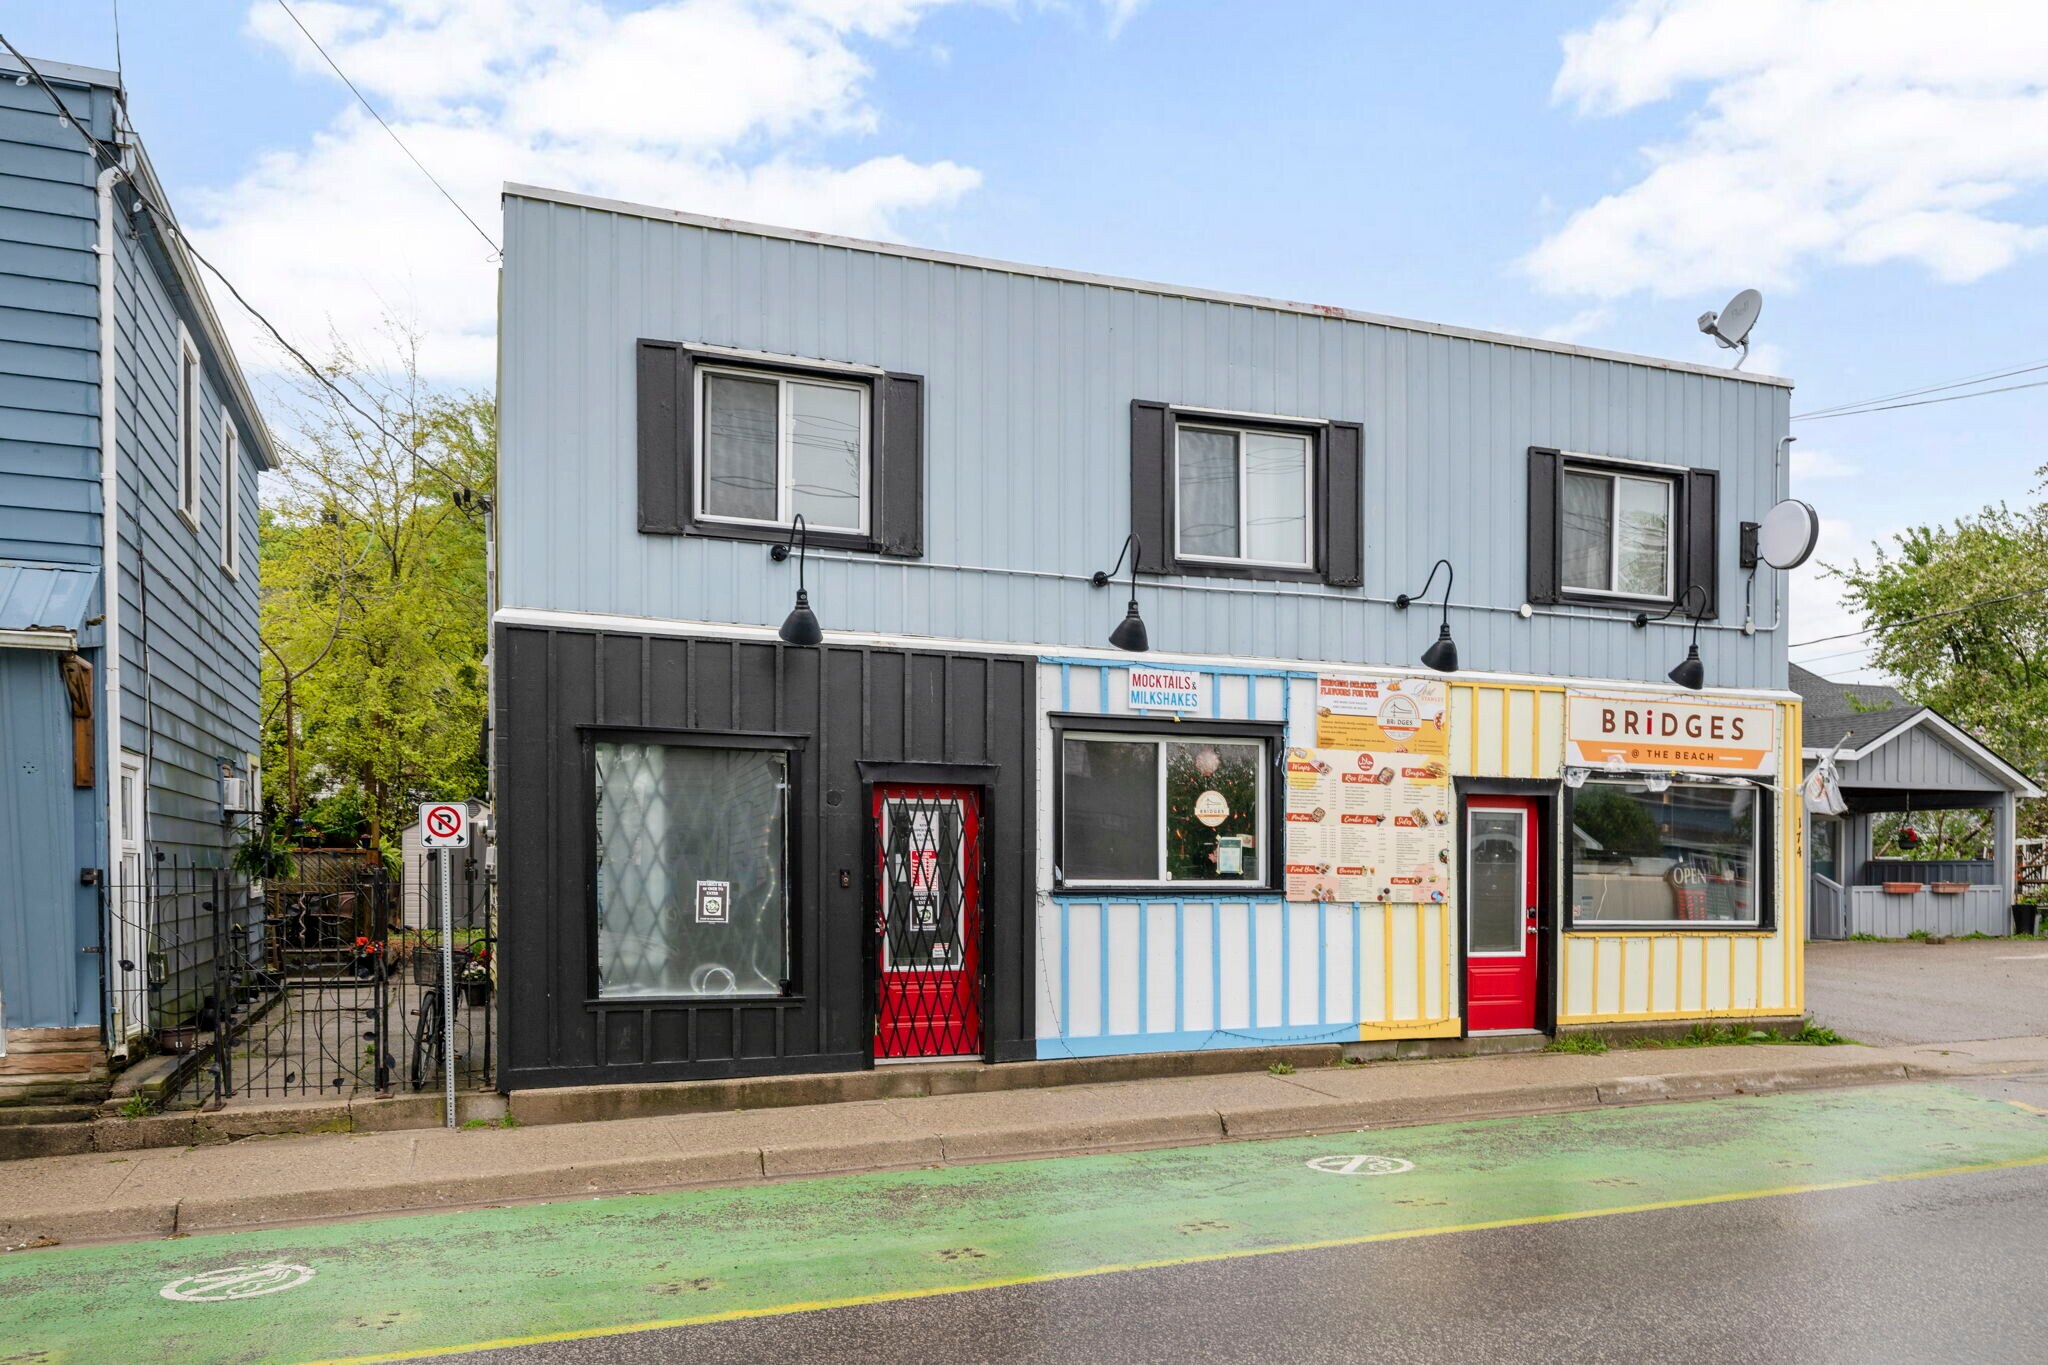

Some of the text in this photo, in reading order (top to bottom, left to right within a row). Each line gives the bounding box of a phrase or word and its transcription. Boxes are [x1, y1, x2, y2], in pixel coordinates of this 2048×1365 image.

[1132, 673, 1191, 690] MOCKTAILS
[1131, 690, 1198, 707] MILKSHAKES
[1631, 749, 1714, 761] @ THE BEACH
[1673, 867, 1707, 885] OPEN
